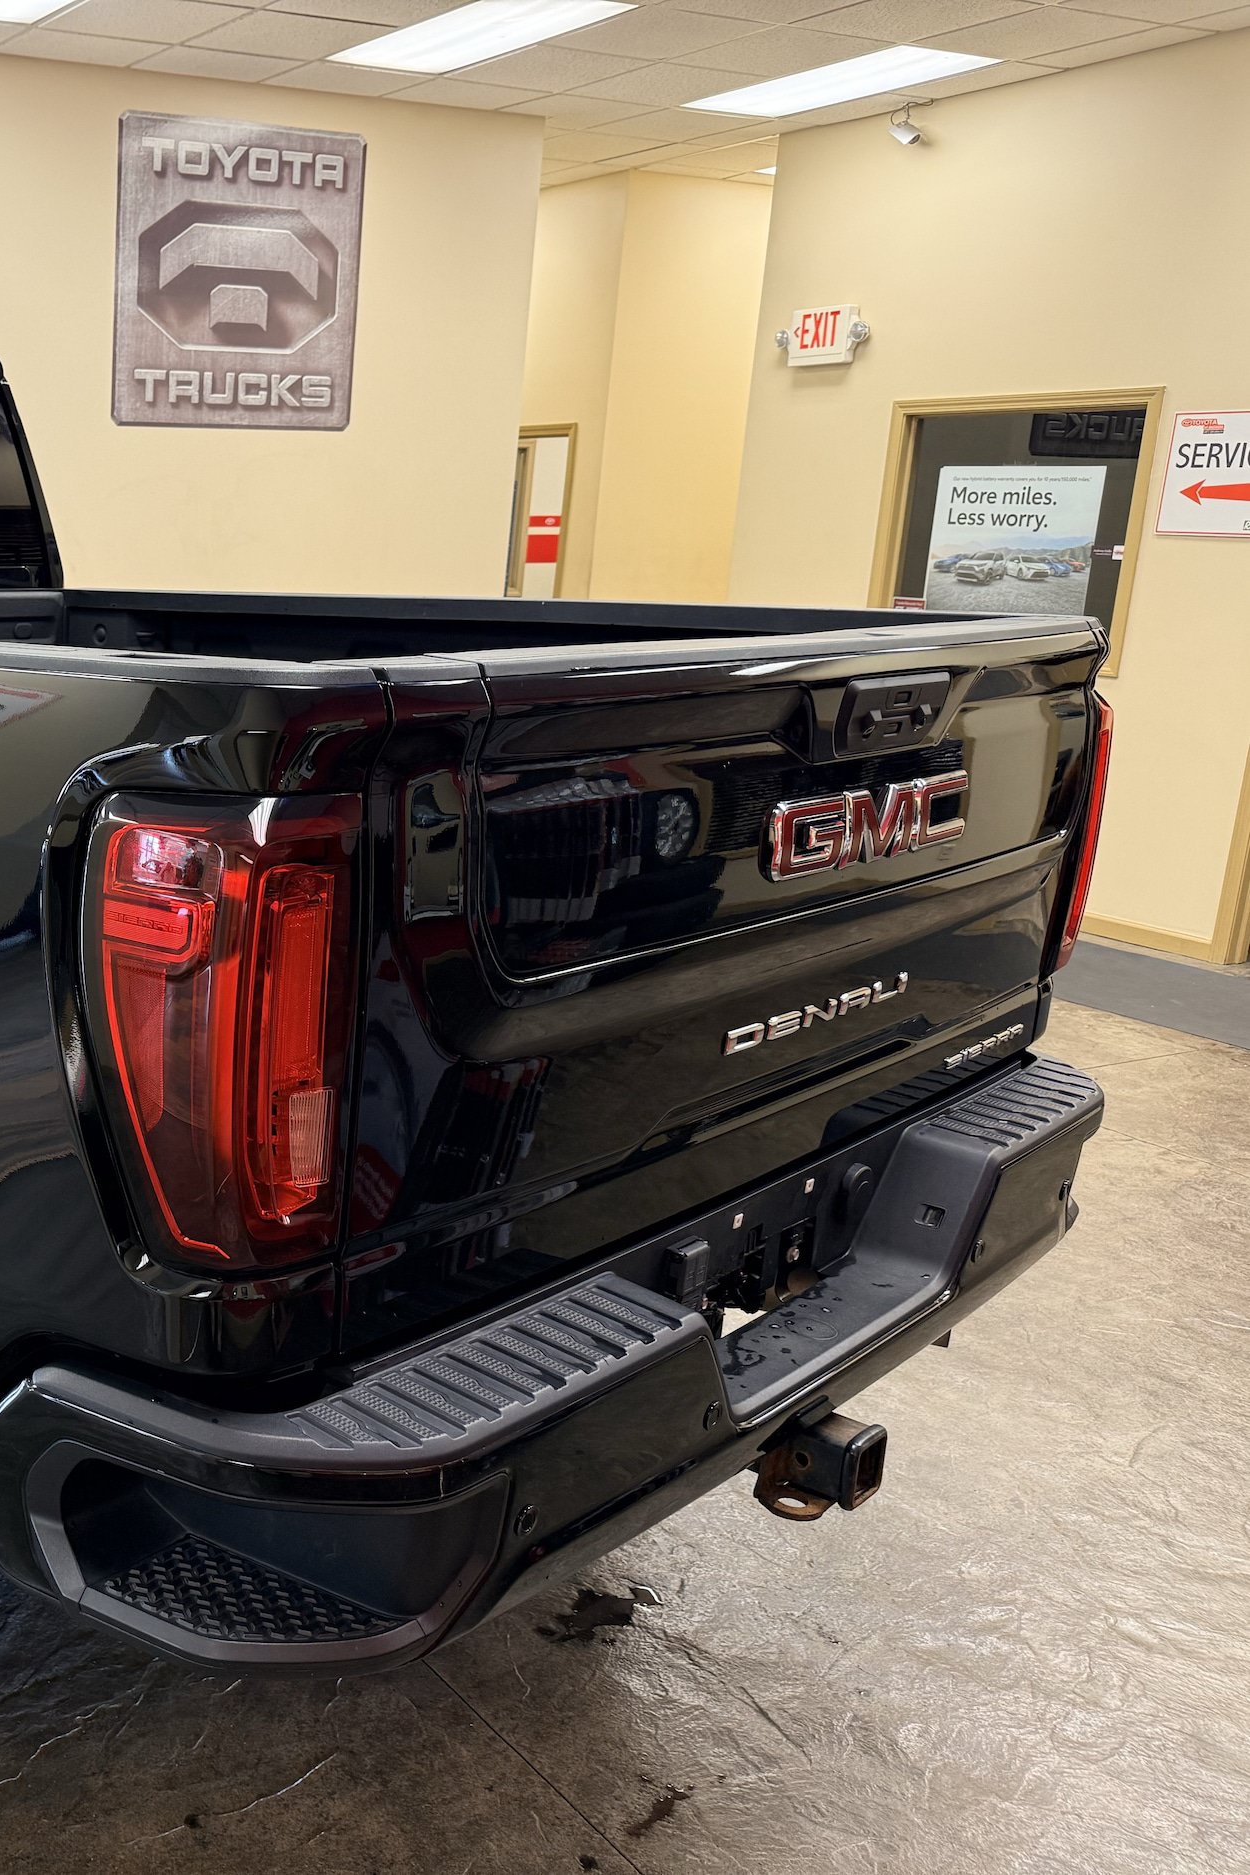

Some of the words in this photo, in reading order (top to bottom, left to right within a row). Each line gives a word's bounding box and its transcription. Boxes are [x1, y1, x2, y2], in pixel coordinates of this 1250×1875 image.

[141, 136, 345, 189] TOYOTA
[799, 310, 841, 350] EXIT
[133, 368, 333, 408] TRUCKS
[1175, 442, 1250, 469] SERVI
[950, 486, 997, 504] More
[1002, 486, 1057, 506] miles.
[947, 508, 986, 526] Less
[991, 513, 1049, 533] worry.
[758, 770, 968, 883] GMC
[104, 910, 184, 935] SIERRA
[723, 971, 909, 1056] DENALI
[943, 1023, 1024, 1070] SIERRA
